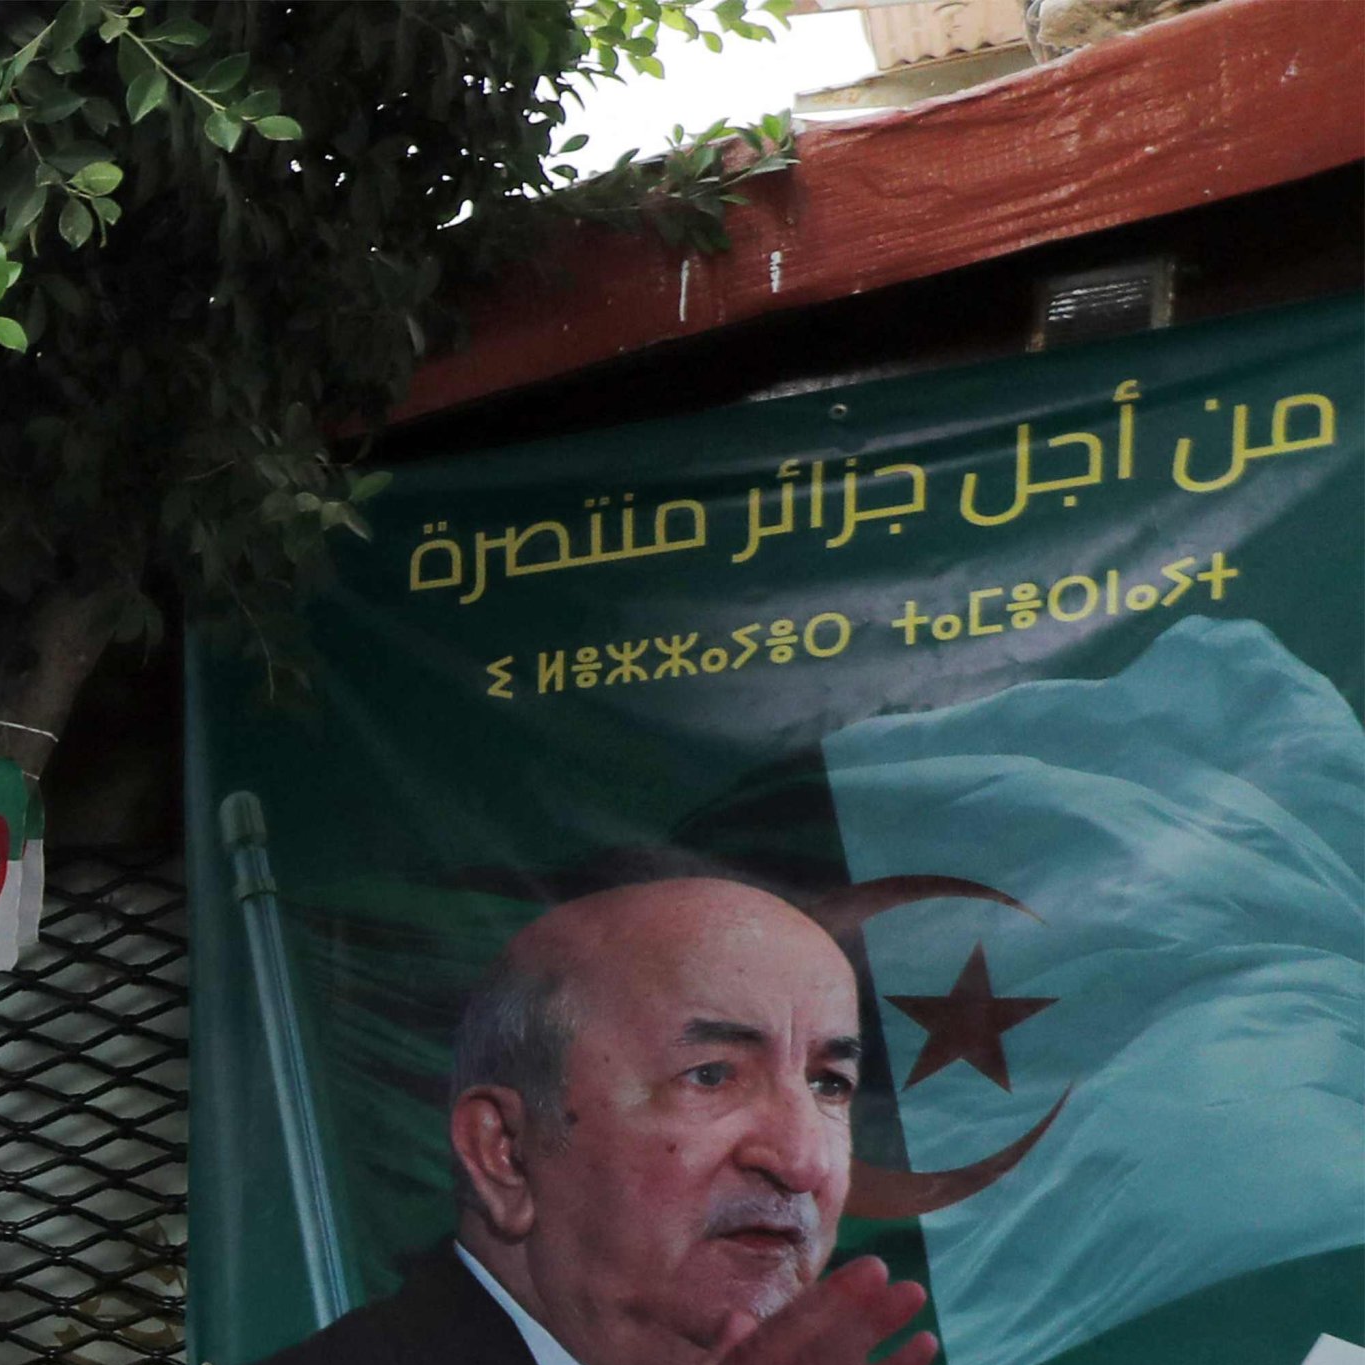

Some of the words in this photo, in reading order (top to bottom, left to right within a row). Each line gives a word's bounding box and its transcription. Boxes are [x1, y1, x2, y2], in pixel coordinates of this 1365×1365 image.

[959, 379, 1142, 527] أجل
[1172, 392, 1335, 493] من
[408, 492, 707, 605] منتصرة
[731, 457, 926, 564] جزائر
